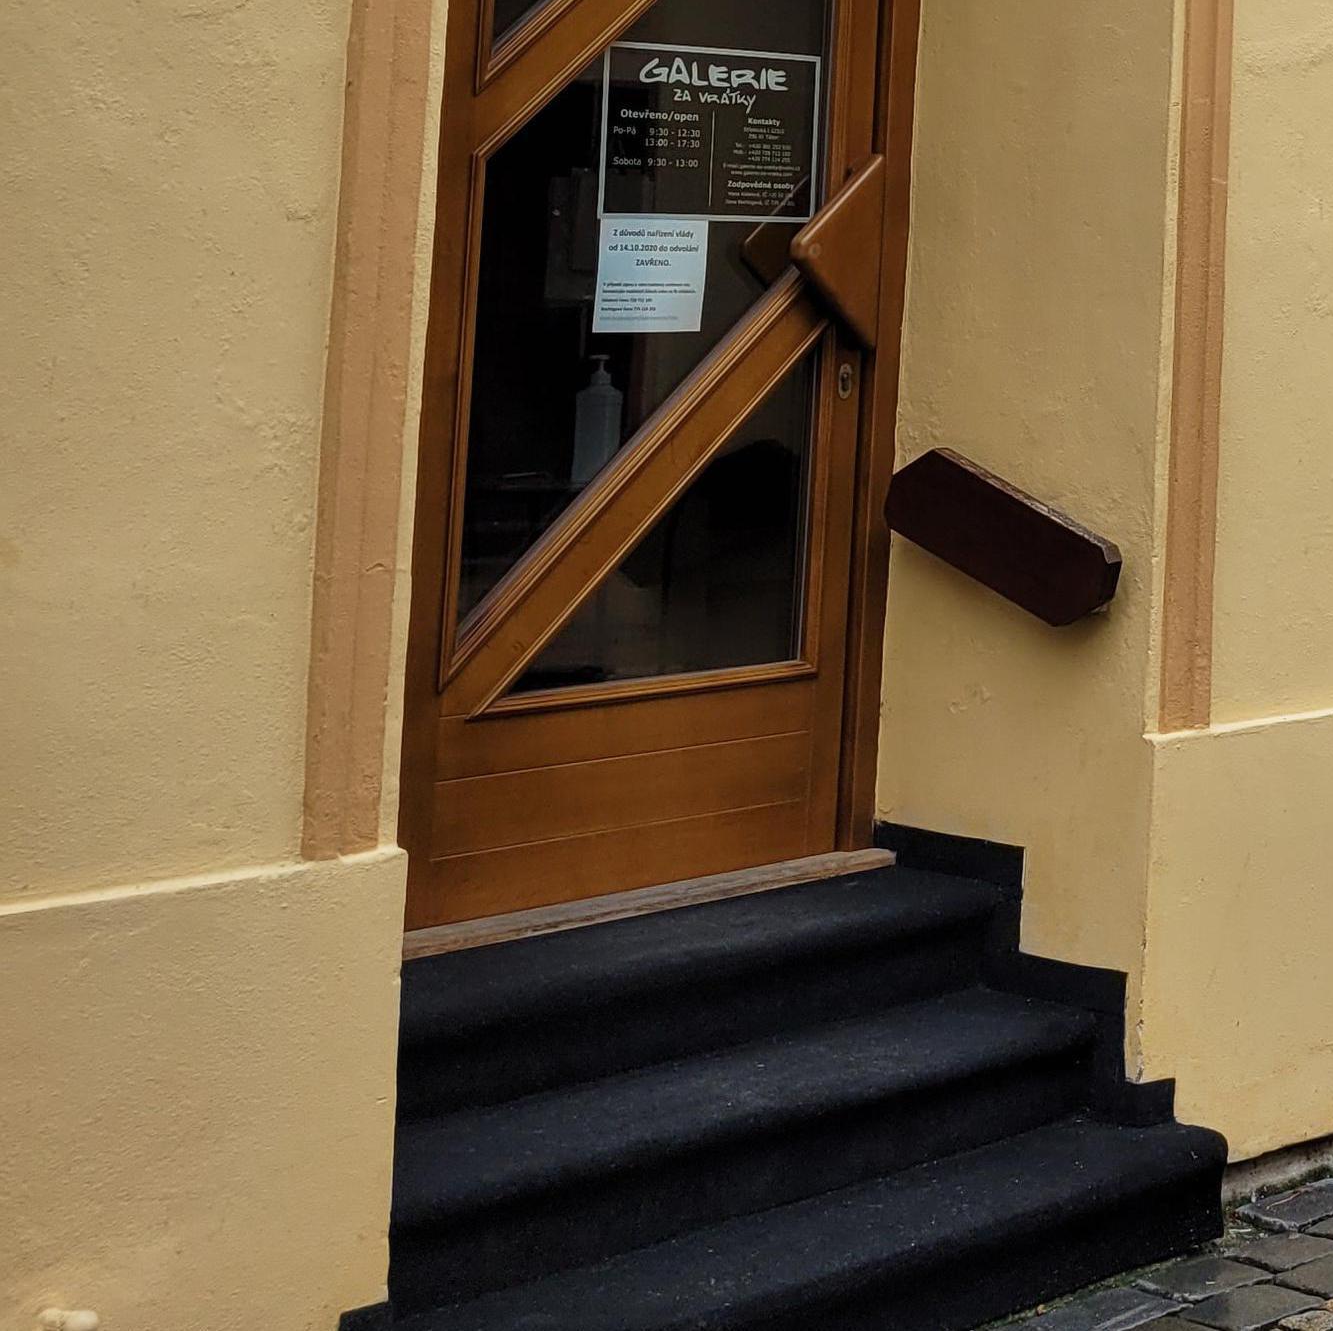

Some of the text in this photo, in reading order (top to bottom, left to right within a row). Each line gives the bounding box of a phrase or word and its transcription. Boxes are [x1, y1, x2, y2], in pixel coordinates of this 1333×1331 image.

[639, 56, 789, 92] GALERIE
[673, 88, 757, 114] ZA VRÁTKY
[620, 109, 699, 122] Otevřeno/open
[748, 118, 781, 127] Kontakty
[649, 128, 668, 136] 9:30
[677, 129, 701, 138] 12:30
[645, 139, 668, 147] 13:00
[677, 140, 700, 148] 17:30
[612, 157, 642, 166] Sobota
[647, 158, 667, 167] 9:30
[676, 159, 699, 167] 13:00
[675, 230, 694, 239] vlády
[619, 244, 658, 252] 14.10.2020
